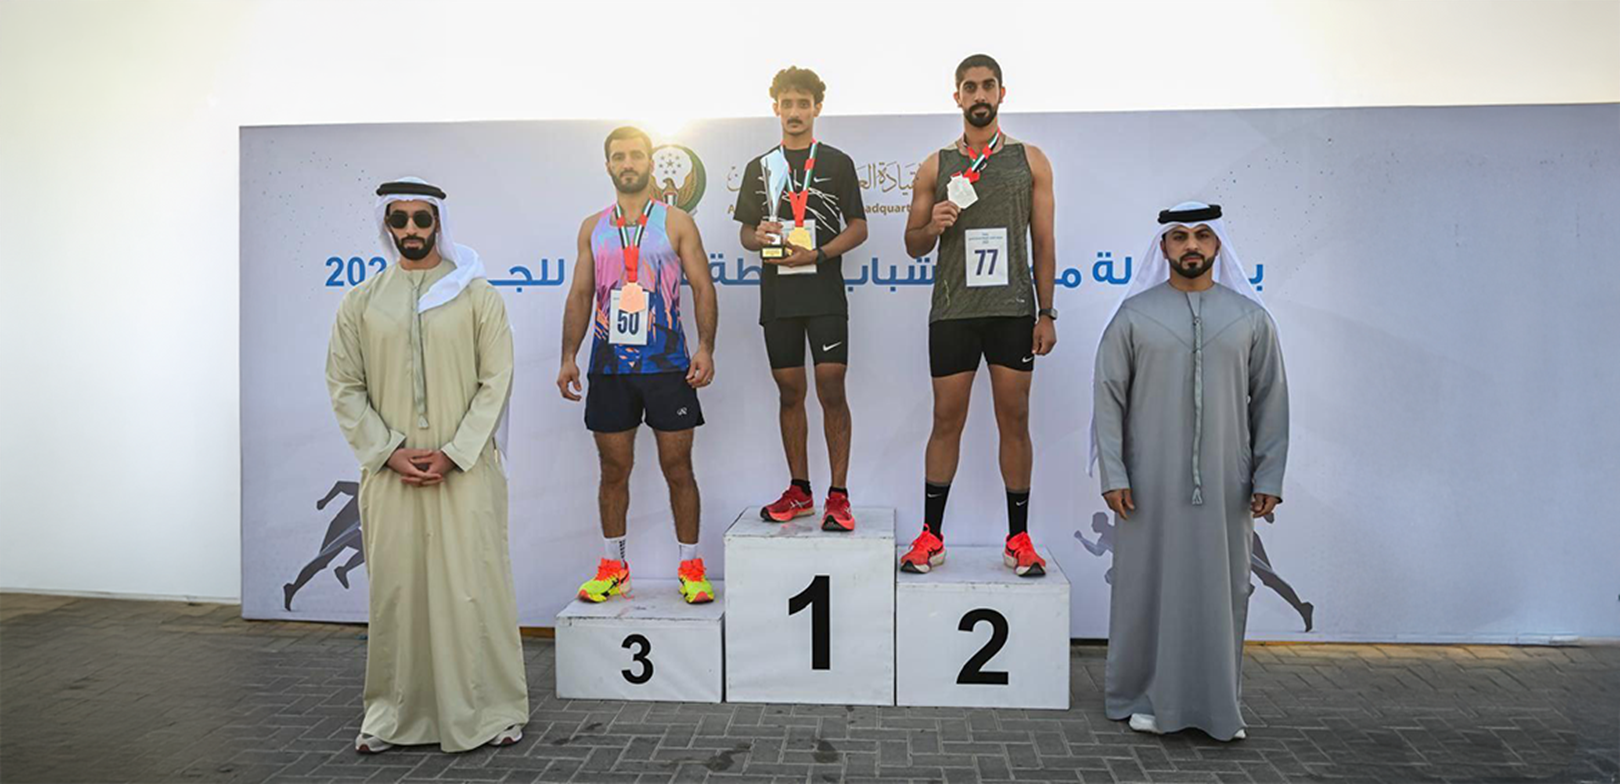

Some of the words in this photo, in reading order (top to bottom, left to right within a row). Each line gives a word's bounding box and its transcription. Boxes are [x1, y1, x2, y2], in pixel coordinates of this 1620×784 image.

[864, 203, 912, 216] adquart
[325, 256, 387, 287] 202
[843, 257, 936, 292] شباب
[974, 248, 999, 276] 77
[617, 309, 640, 335] 50
[788, 575, 831, 670] 1
[621, 633, 654, 685] 3
[956, 608, 1009, 685] 2
